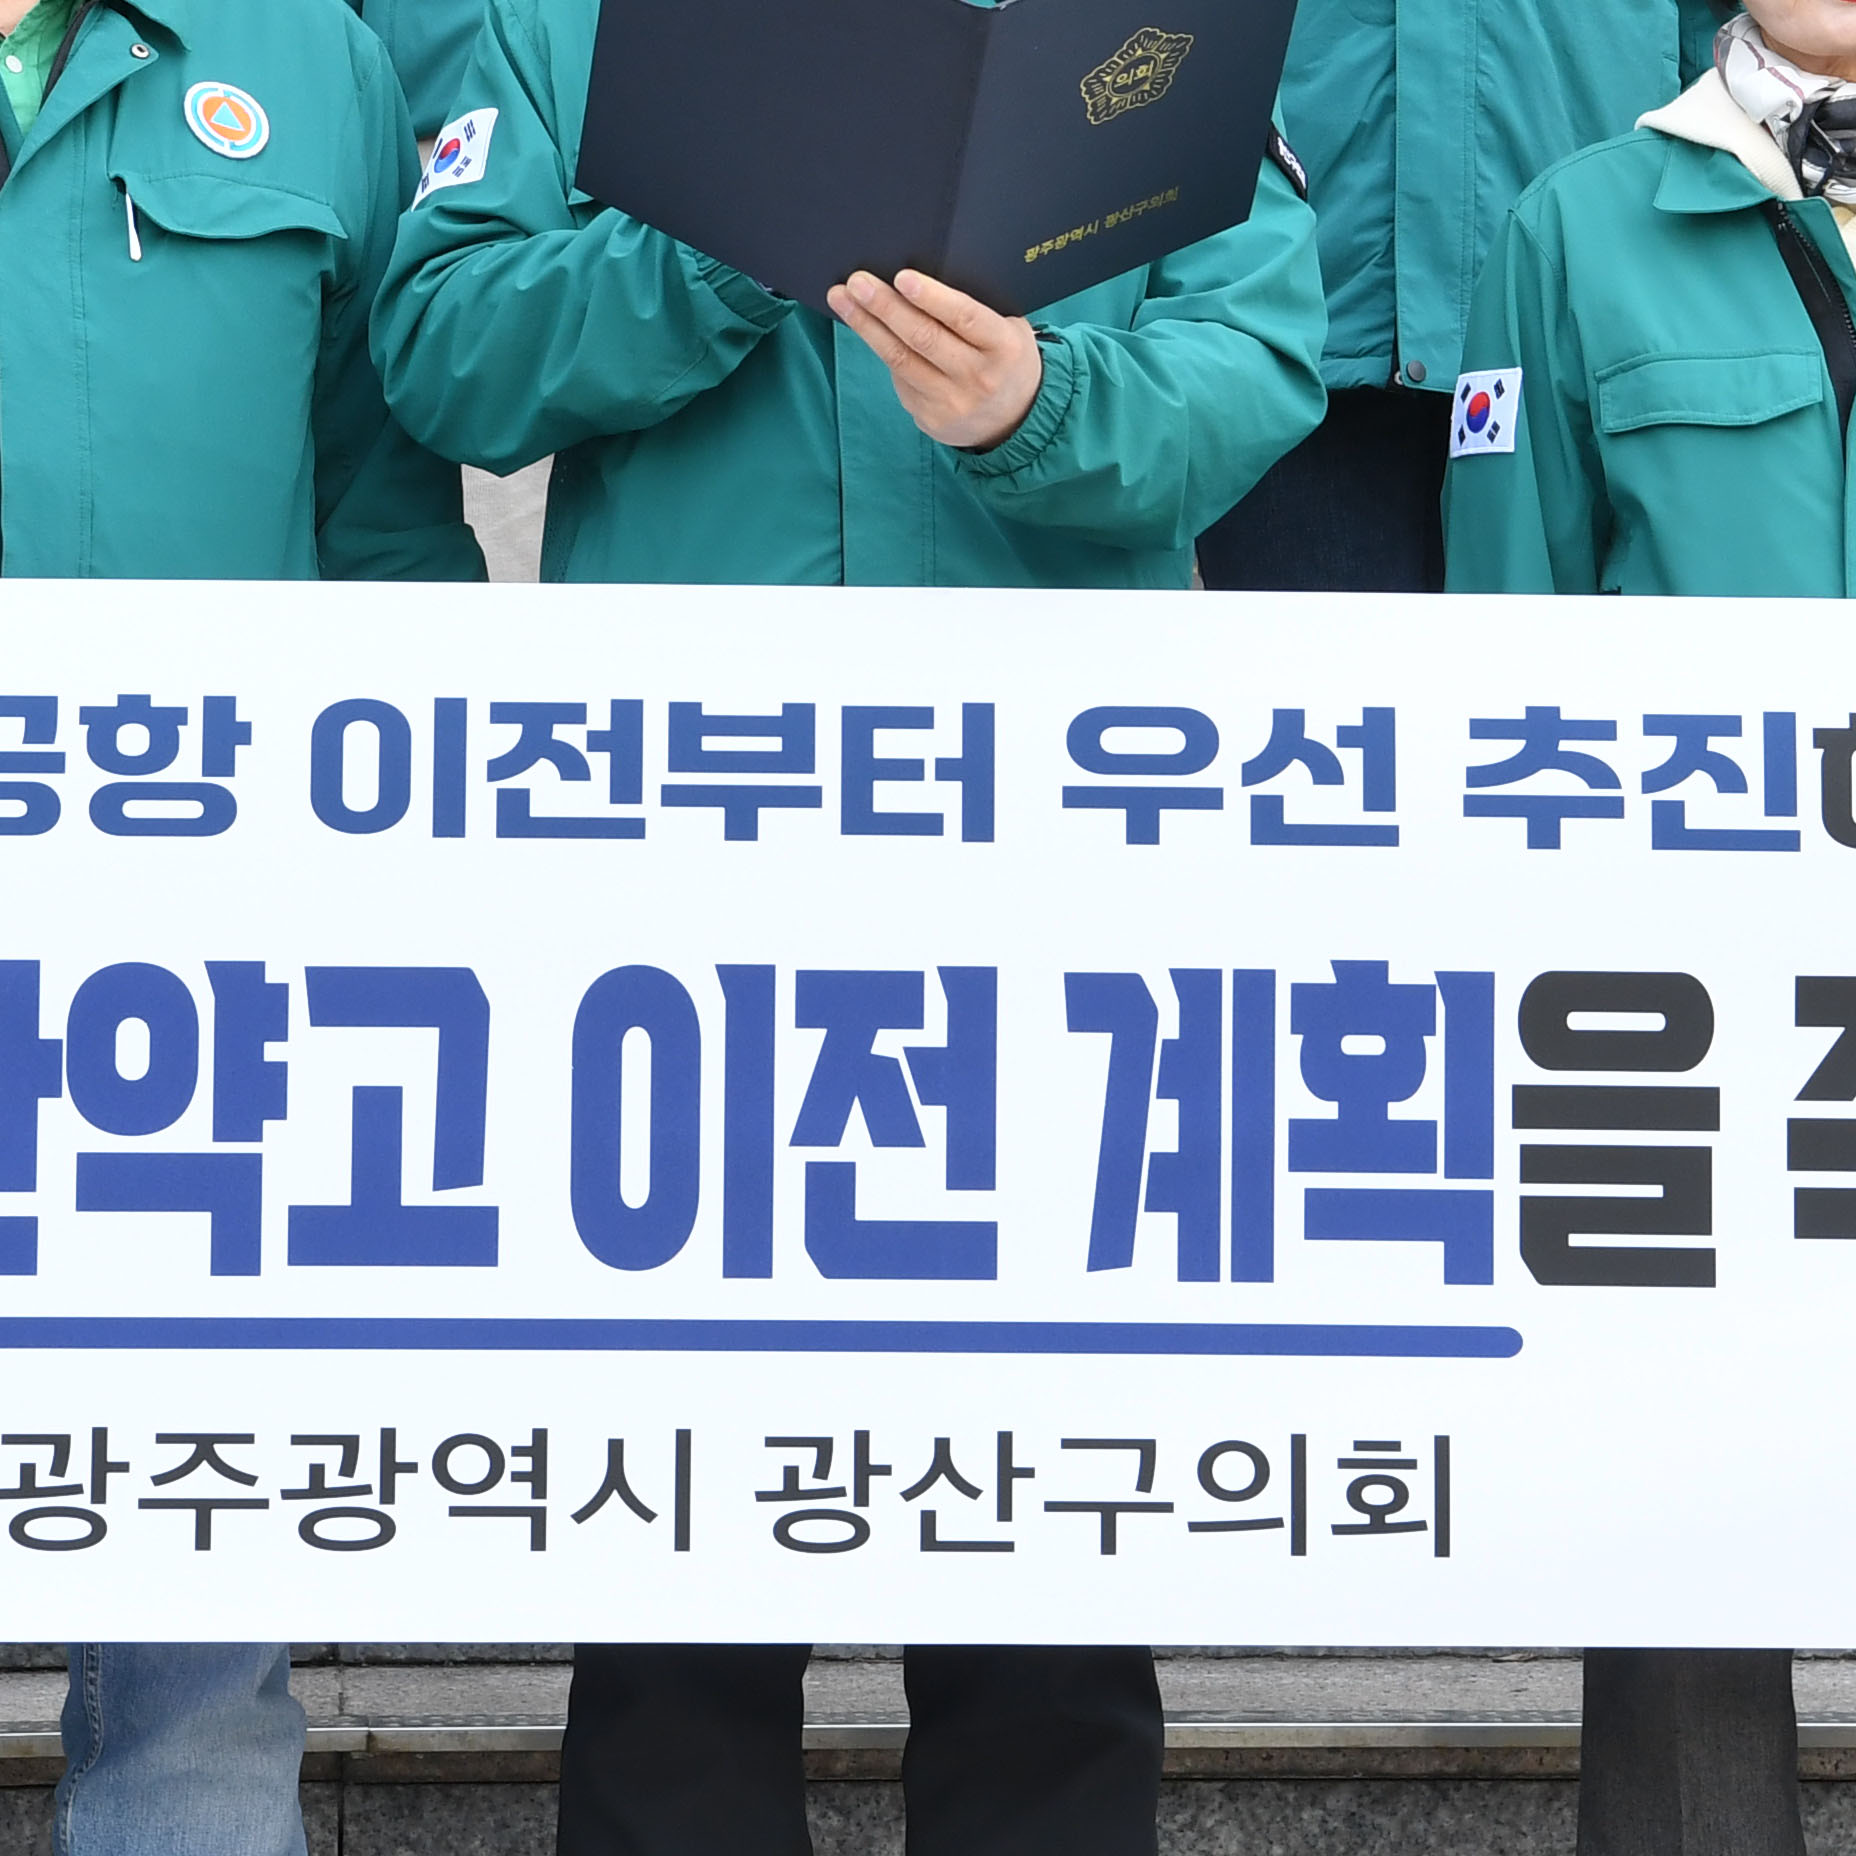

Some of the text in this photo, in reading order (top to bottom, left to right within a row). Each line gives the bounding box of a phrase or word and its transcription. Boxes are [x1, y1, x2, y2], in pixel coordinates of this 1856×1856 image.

[1113, 60, 1157, 88] 의회
[1024, 186, 1179, 263] 광주광역시 광산구의회
[311, 698, 994, 842] 이전부터
[1062, 706, 1399, 848] 우선
[571, 964, 997, 1281] 이전
[1064, 960, 1720, 1287] 계획을
[755, 1430, 1450, 1558] 광산구의회
